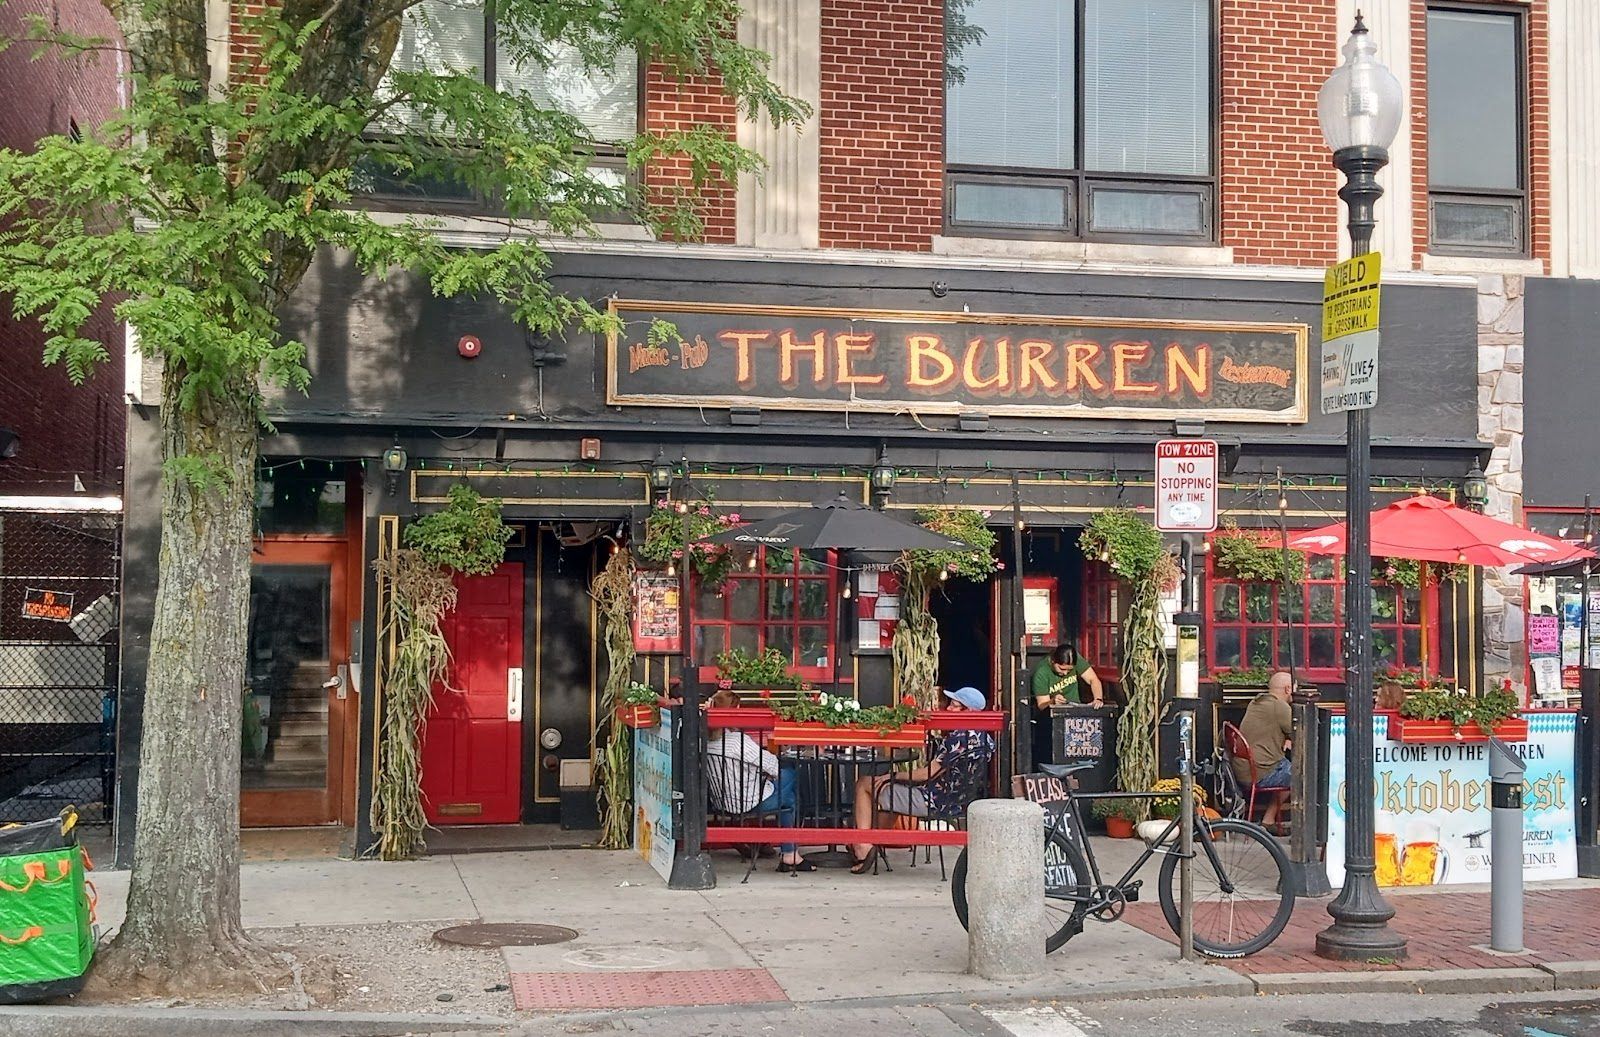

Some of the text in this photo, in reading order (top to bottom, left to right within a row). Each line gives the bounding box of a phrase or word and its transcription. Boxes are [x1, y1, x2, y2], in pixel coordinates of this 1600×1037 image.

[1334, 261, 1366, 289] YIELD
[1334, 295, 1372, 317] PEDESTRIANS
[1335, 313, 1368, 334] CROSSWALK
[679, 334, 709, 370] Pub
[717, 328, 1213, 398] THE BURREN
[1350, 358, 1375, 378] LIVES
[1350, 376, 1369, 385] program
[1359, 390, 1372, 405] FINE
[1159, 444, 1214, 456] TOW ZONE
[1177, 462, 1195, 474] NO
[1161, 477, 1212, 489] STOPPING
[1168, 492, 1206, 502] ANY TIME
[1049, 674, 1077, 694] AMESON
[1065, 718, 1101, 734] PLEASE
[1066, 746, 1100, 757] SEATED
[1375, 744, 1545, 763] ELCOME TO THE RREN
[1026, 777, 1069, 804] PLEASE
[1338, 770, 1566, 815] ktoberest
